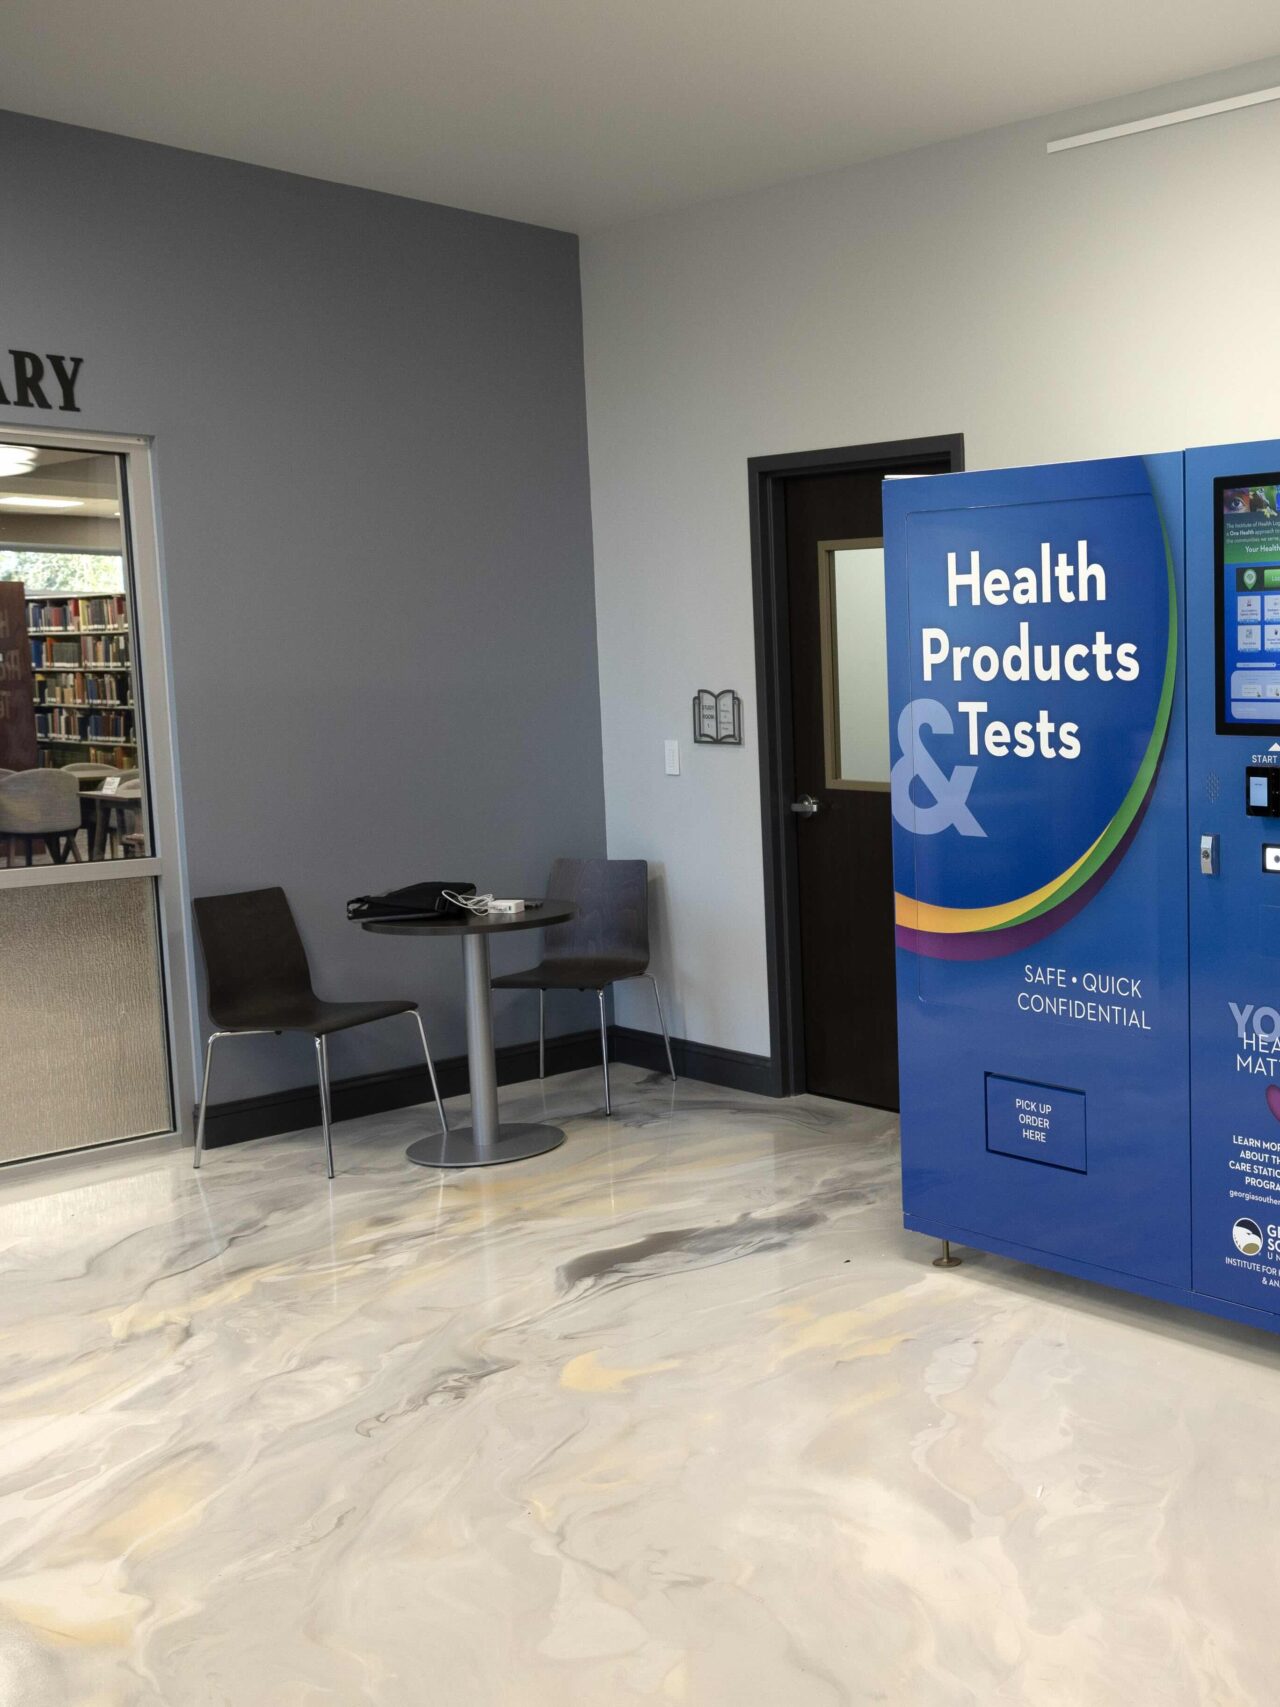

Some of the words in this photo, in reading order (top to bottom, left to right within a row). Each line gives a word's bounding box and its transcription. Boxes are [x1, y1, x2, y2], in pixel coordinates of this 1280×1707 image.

[1260, 544, 1280, 552] Health
[947, 539, 1106, 607] Health
[921, 621, 1140, 682] Products
[1252, 754, 1277, 764] START
[890, 698, 988, 838] &
[958, 701, 1081, 759] Tests
[1024, 964, 1066, 988] SAFE
[1082, 972, 1142, 999] QUICK
[1017, 992, 1151, 1030] CONFIDENTIAL
[1016, 1098, 1036, 1112] PICK
[1039, 1103, 1052, 1115] UP
[1018, 1114, 1050, 1130] ORDER
[1022, 1128, 1046, 1143] HERE
[1232, 1134, 1260, 1148] LEARN
[1240, 1150, 1270, 1163] ABOUT
[1228, 1160, 1252, 1173] CARE
[1225, 1256, 1261, 1272] INSTITUTE
[1262, 1265, 1277, 1277] FOR
[1262, 1276, 1268, 1285] &
